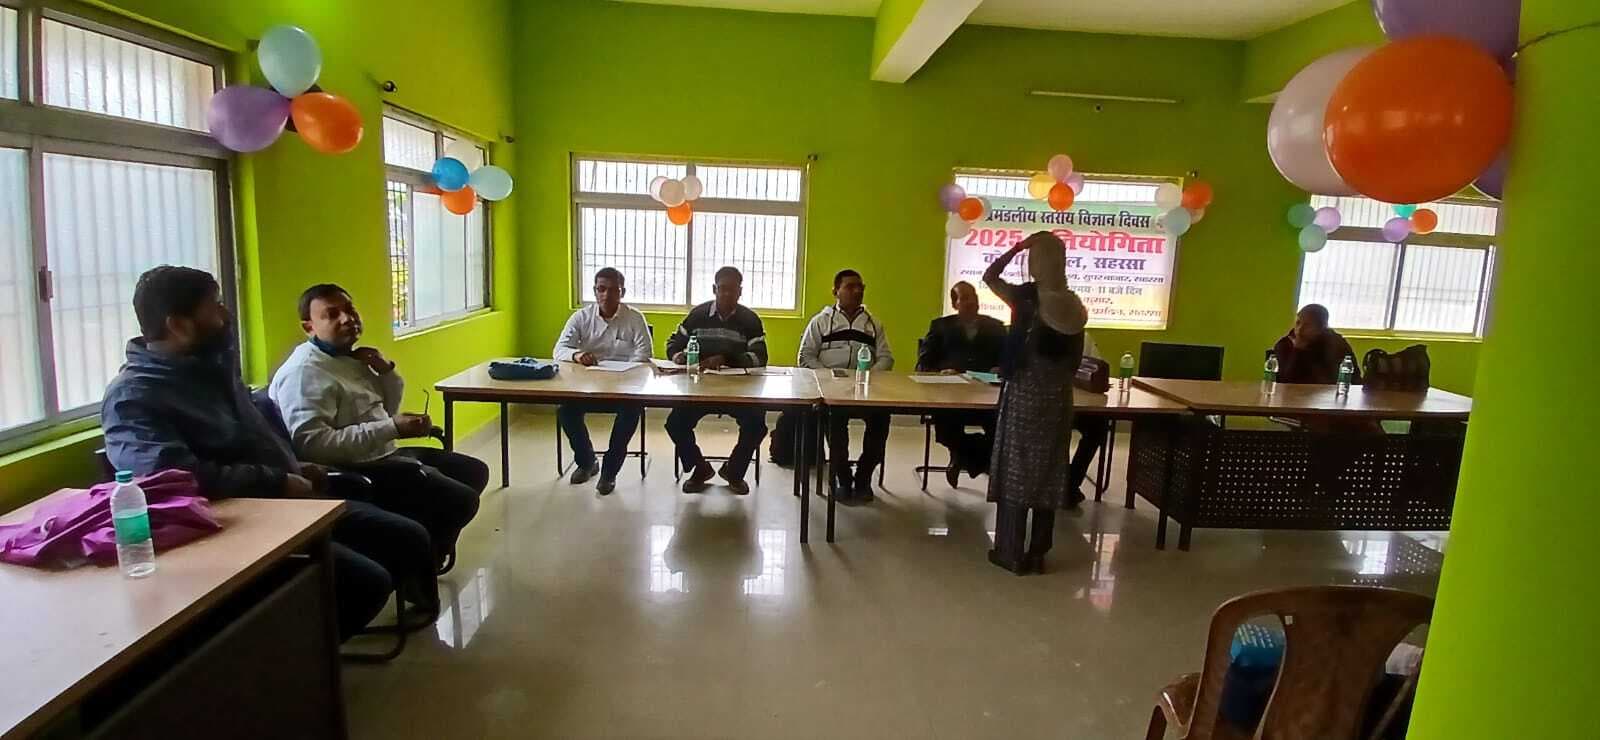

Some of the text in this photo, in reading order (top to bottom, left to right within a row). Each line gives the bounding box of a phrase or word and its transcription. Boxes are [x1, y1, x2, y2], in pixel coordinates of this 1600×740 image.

[1078, 208, 1116, 226] विज्ञान
[1118, 210, 1151, 229] दिवस
[964, 228, 1167, 254] 2025 तियोगिता
[1093, 256, 1147, 271] सहरसा
